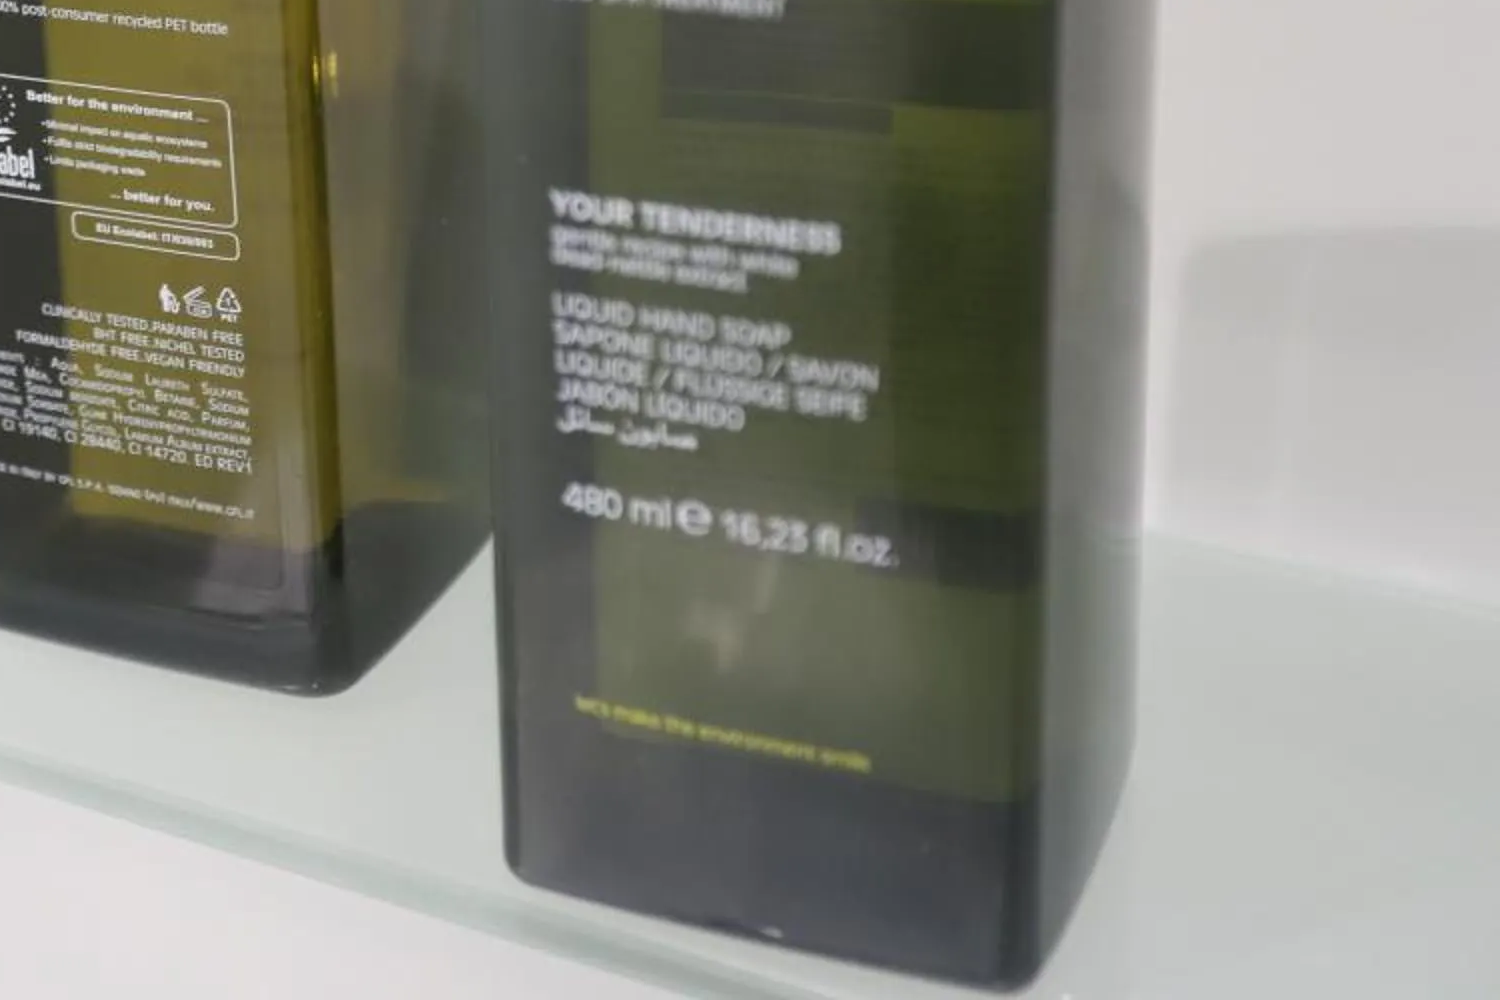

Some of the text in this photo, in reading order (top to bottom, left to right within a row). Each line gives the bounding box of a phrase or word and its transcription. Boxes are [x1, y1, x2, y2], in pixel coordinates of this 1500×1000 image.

[112, 12, 162, 30] recycled
[165, 16, 189, 32] PET
[191, 18, 228, 36] bottle
[26, 89, 64, 106] Better
[67, 96, 86, 108] for
[88, 98, 108, 111] the
[111, 102, 193, 122] environment
[123, 189, 161, 206] better
[163, 194, 182, 208] for
[185, 199, 215, 214] you.
[549, 185, 842, 256] YOUR TENDERNESS
[41, 302, 102, 323] CLINICALLY
[212, 328, 244, 347] FREE
[551, 288, 792, 351] LIQUID HAND SOAP
[15, 329, 107, 357] FORMALDEHYDE
[189, 358, 246, 378] FRIENDLY
[201, 344, 245, 362] TESTED
[552, 317, 655, 361] SAPONE
[660, 338, 763, 378] LIQUIDO
[785, 352, 880, 392] SAVON
[554, 348, 649, 387] LIQUIDE
[794, 385, 868, 422] SEIFE
[561, 481, 623, 520] 480
[628, 496, 672, 531] ml
